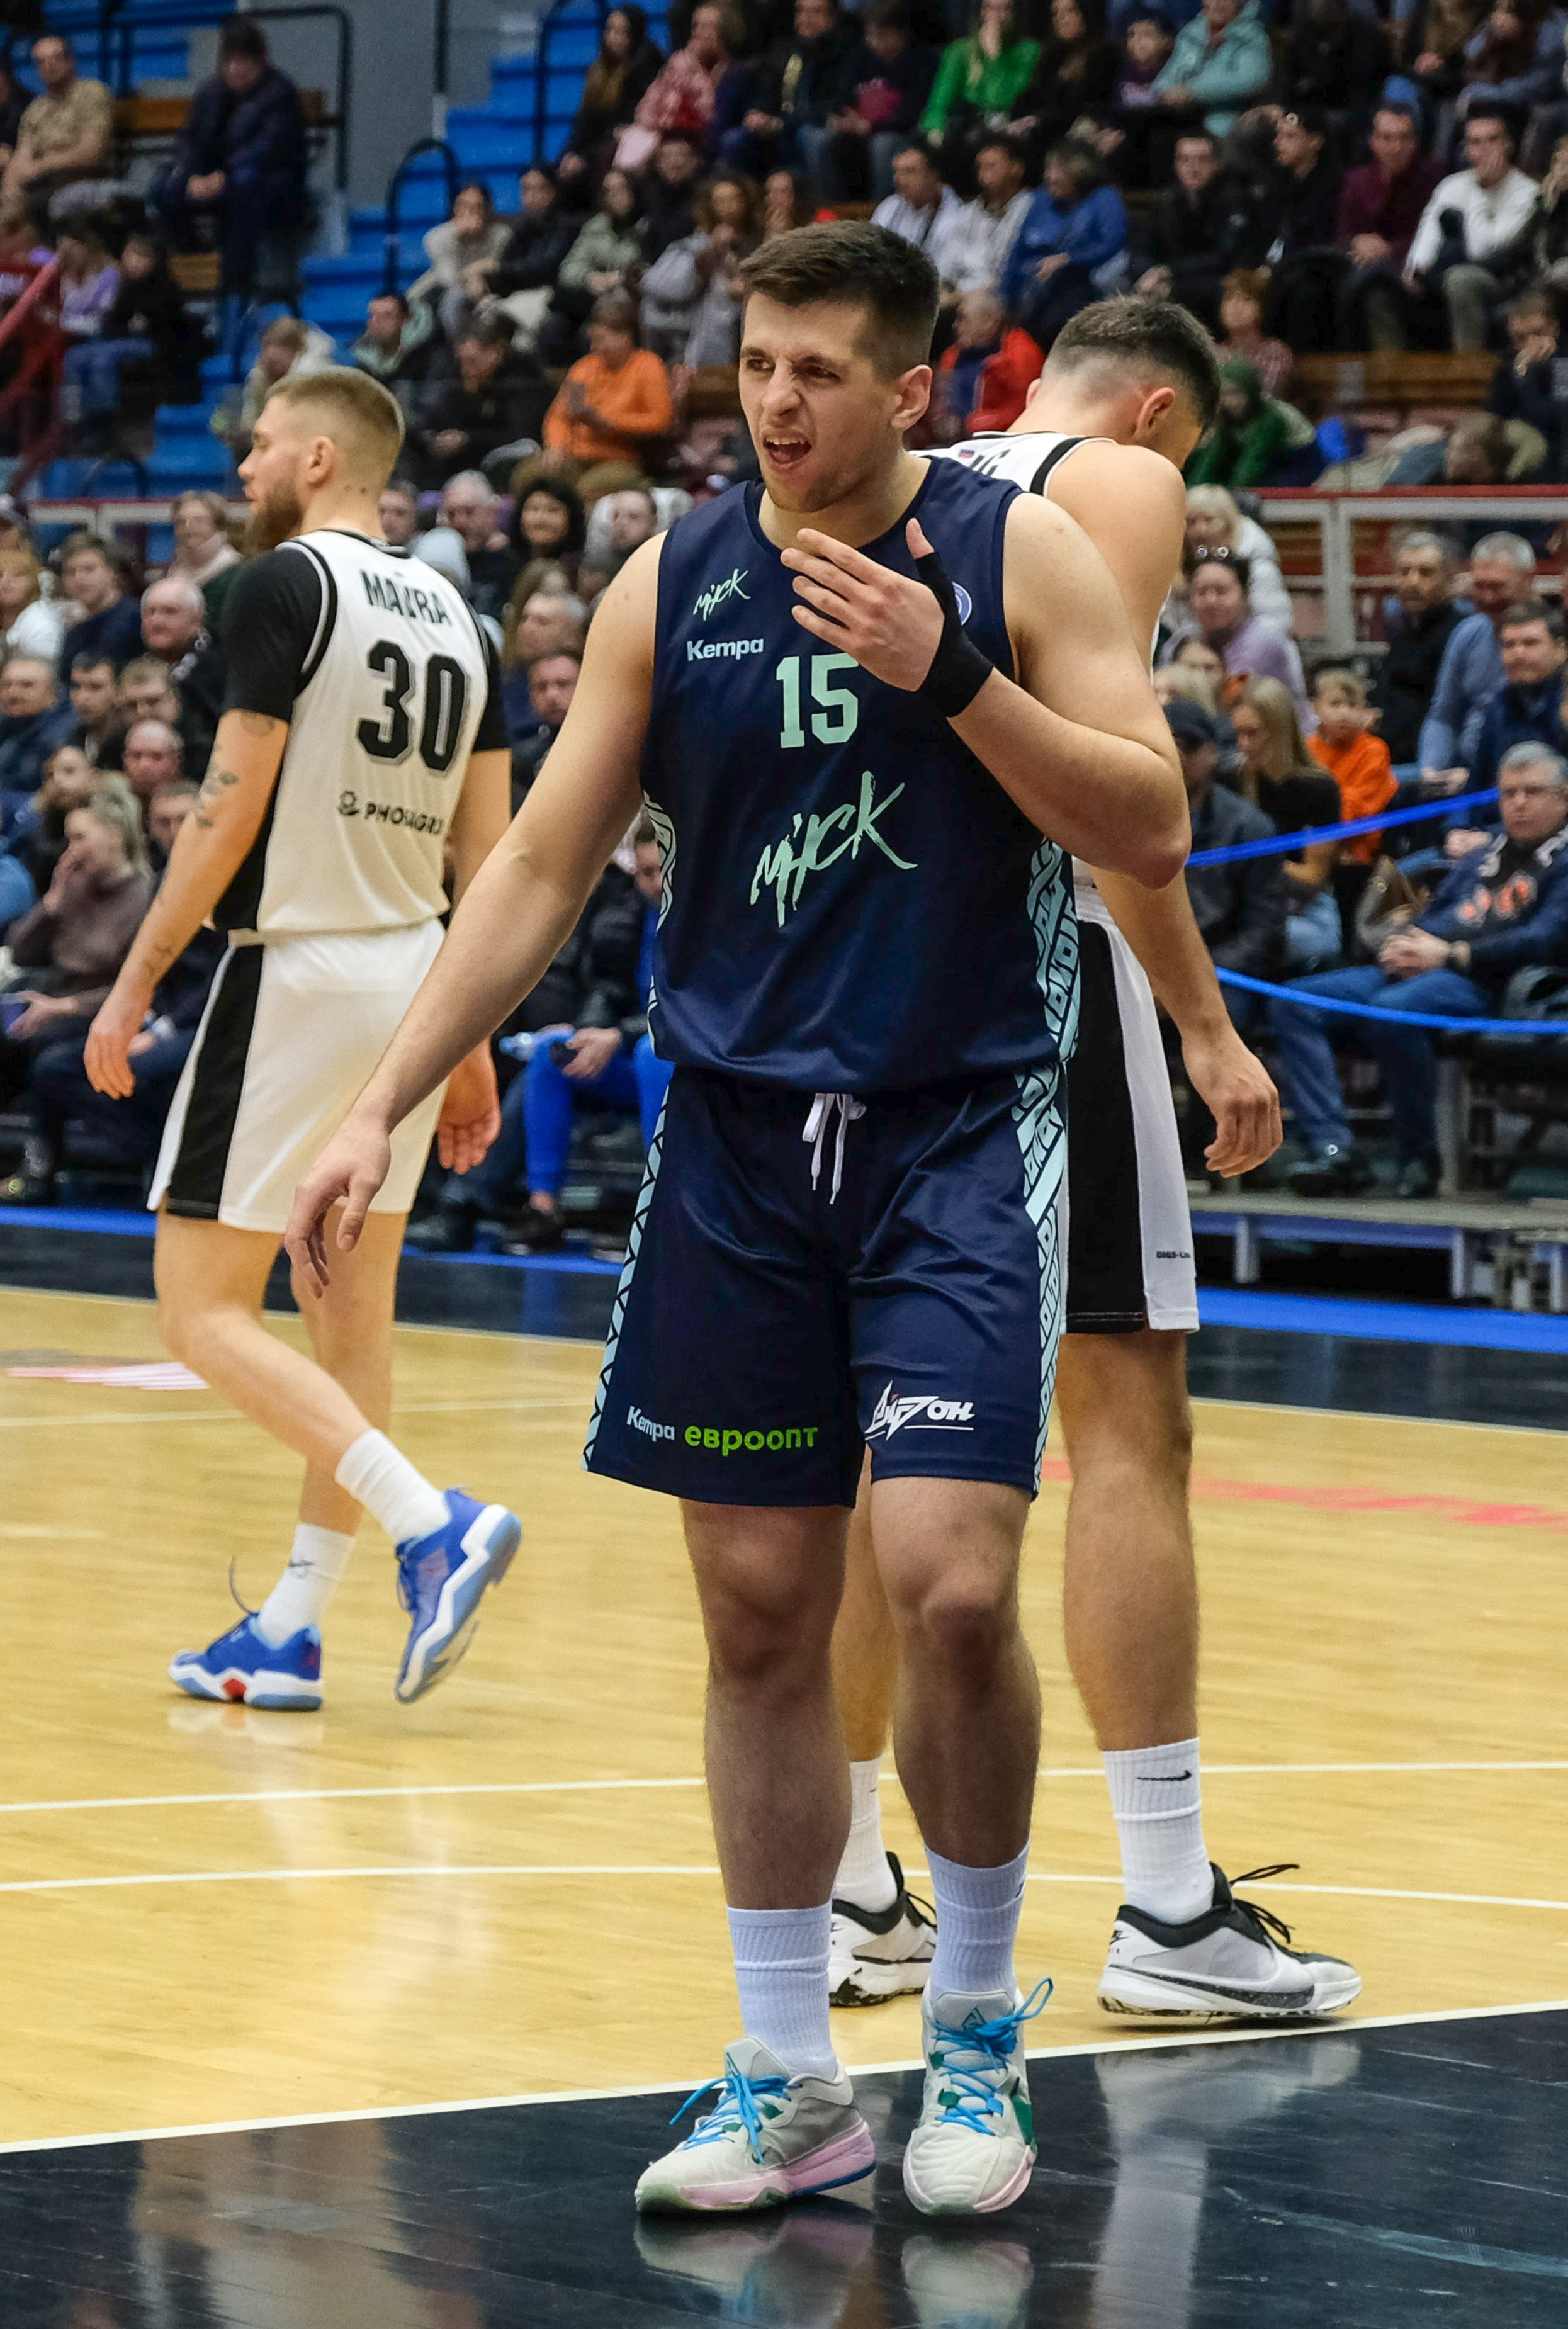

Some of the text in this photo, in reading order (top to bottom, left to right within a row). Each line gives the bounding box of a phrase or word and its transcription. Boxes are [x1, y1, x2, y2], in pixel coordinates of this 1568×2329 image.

[687, 638, 764, 661] Kempa
[357, 640, 469, 776] 30
[776, 653, 859, 748] 15
[626, 1406, 675, 1442] Kempa
[685, 1426, 818, 1457] евроопт
